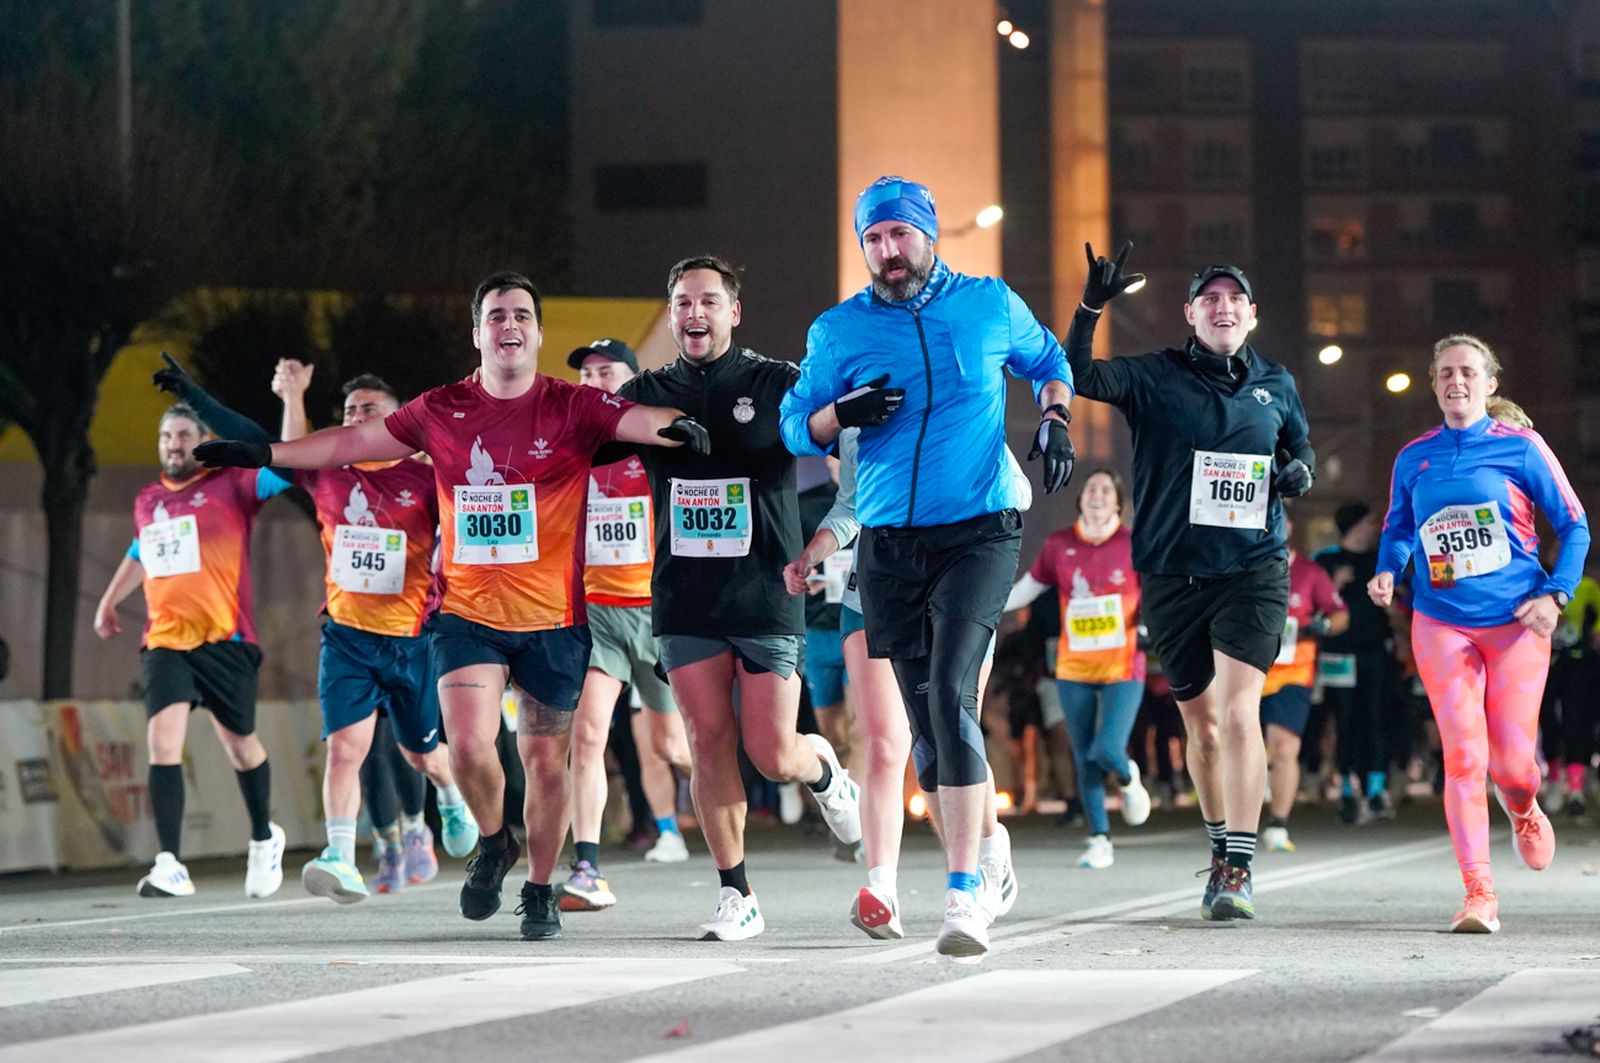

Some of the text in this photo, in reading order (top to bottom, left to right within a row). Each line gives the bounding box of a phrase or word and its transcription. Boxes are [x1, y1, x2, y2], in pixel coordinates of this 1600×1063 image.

[1214, 461, 1237, 470] NOCHE
[1203, 469, 1219, 478] SAN
[469, 494, 503, 502] NOCHE DE
[684, 488, 719, 497] NOCHE DE
[1209, 479, 1255, 503] 1660
[462, 503, 476, 512] SAN
[677, 497, 690, 506] SAN
[467, 513, 521, 537] 3030
[682, 507, 737, 531] 3032
[595, 522, 636, 542] 1880
[1436, 527, 1493, 555] 3596
[351, 550, 385, 571] 545
